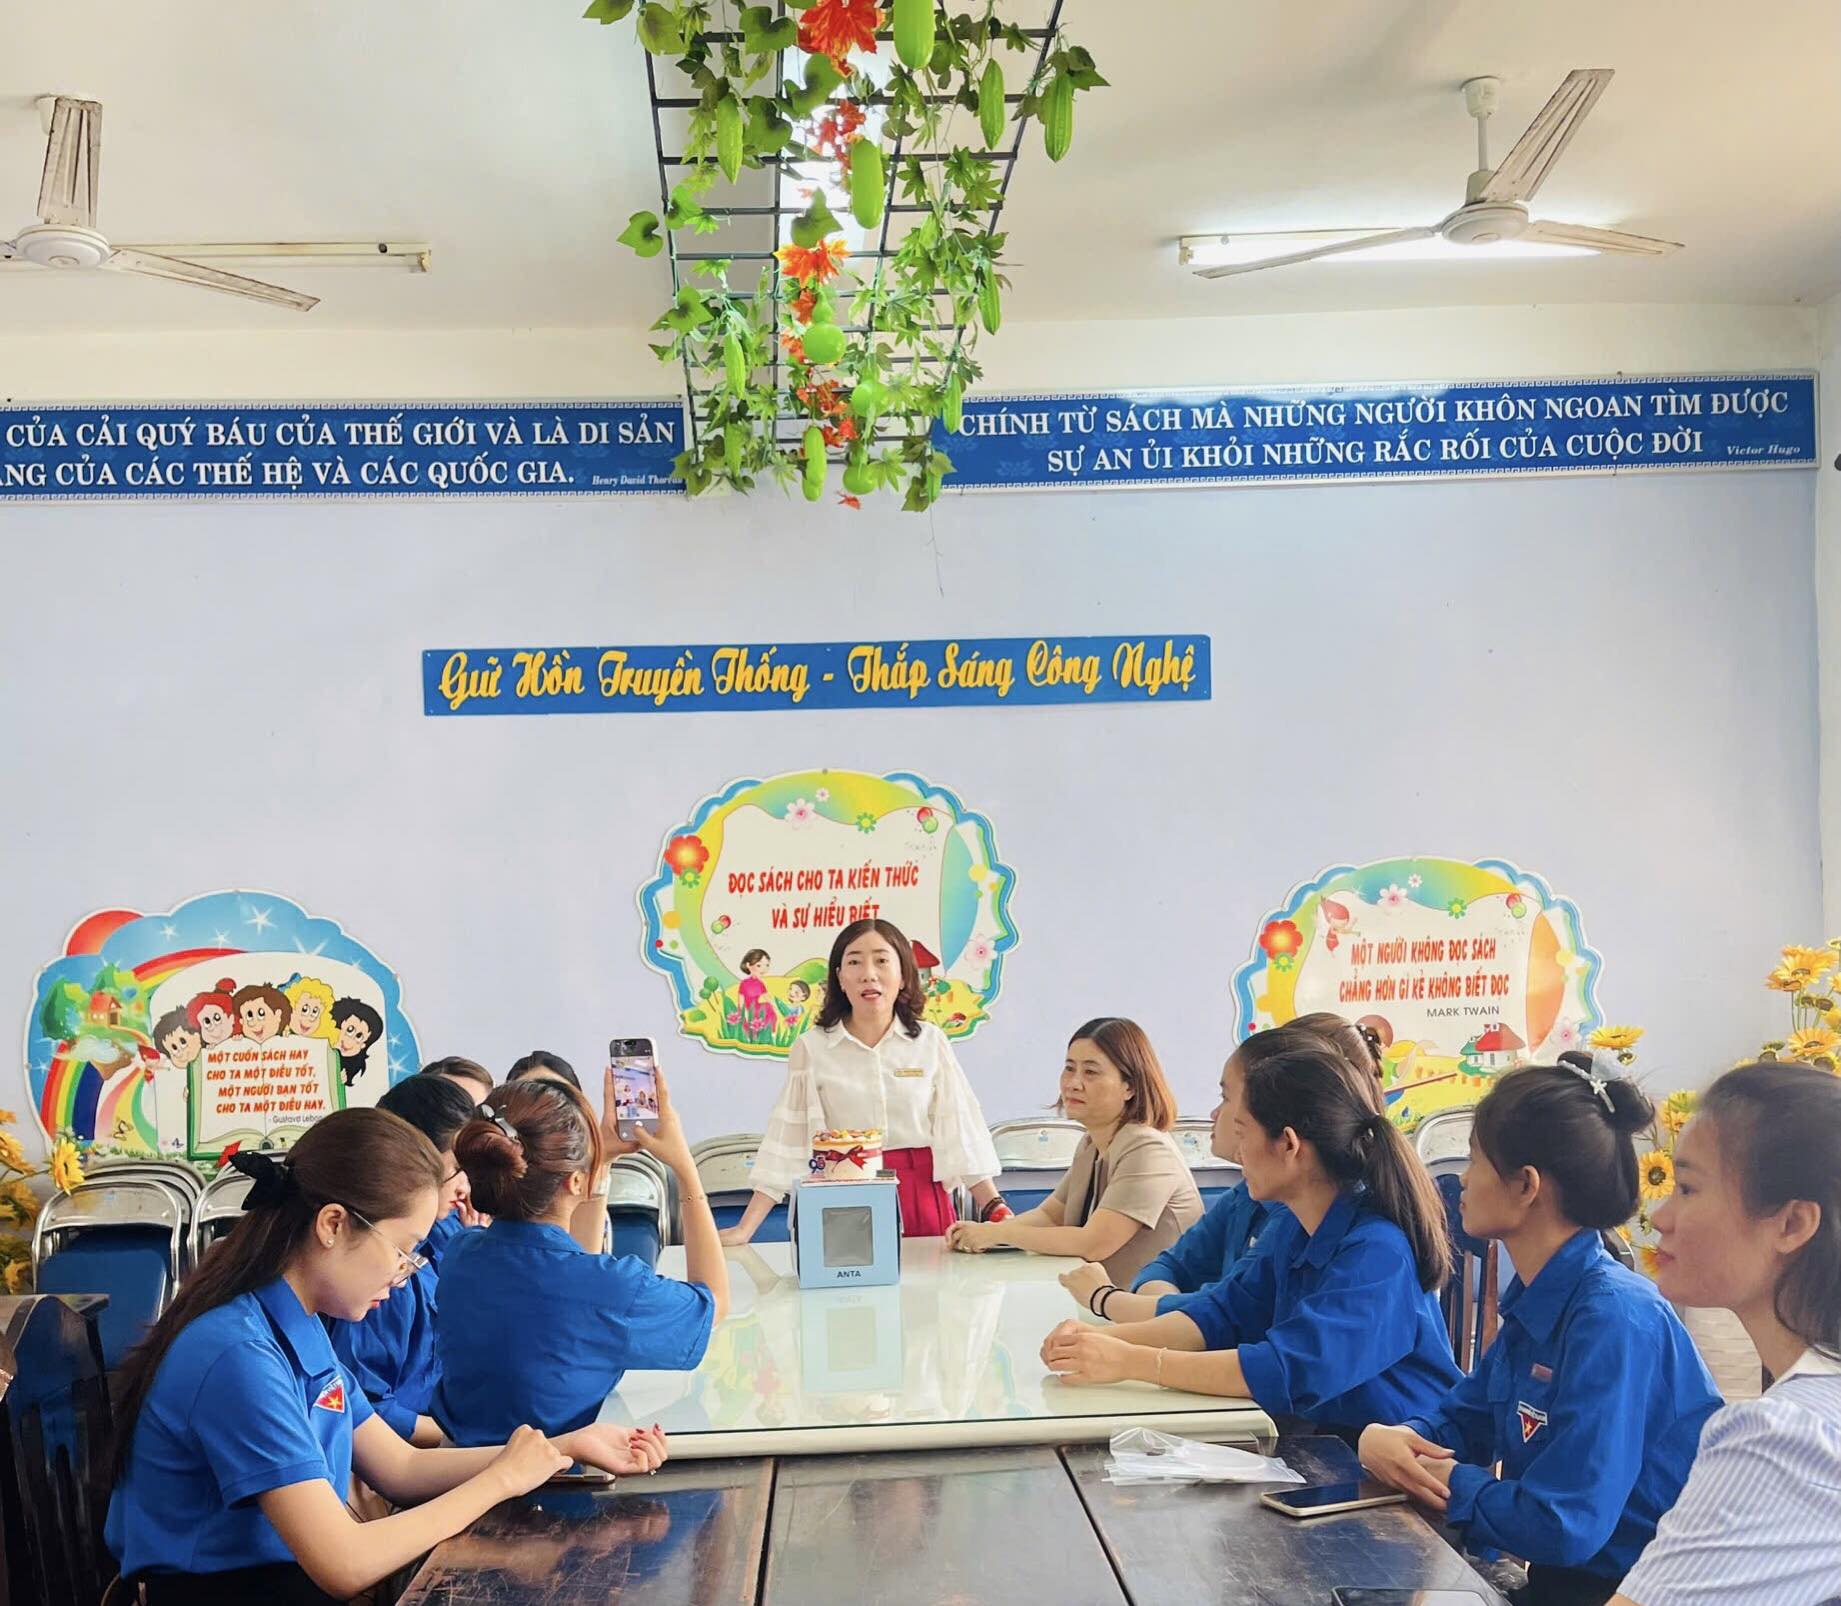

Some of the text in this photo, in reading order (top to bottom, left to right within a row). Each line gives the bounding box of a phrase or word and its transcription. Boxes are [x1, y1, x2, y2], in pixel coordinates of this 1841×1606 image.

[958, 387, 1789, 437] CHÍNH TỪ SÁCH MÀ NHỮNG NGƯỜI KHÔN NGOAN TÌM ĐƯỢC
[6, 412, 675, 450] CỦA CẢI QUÝ BÁU CỦA THẾ GIỚI VÀ LÀ DI SẢN
[1047, 425, 1703, 477] SỰ AN ỦI KHỎI NHỮNG RẮC RỐI CỦA CUỘC ĐỜI
[1726, 443, 1801, 456] Victor Hugo
[0, 451, 575, 491] NG CỦA CÁC THẾ HỆ VÀ CÁC QUỐC GIA.
[591, 474, 618, 487] Henry
[620, 474, 646, 484] David
[512, 649, 585, 698] Hồn
[598, 649, 704, 706] Truyền
[711, 645, 810, 703] Thống
[847, 642, 931, 699] Thắp
[938, 642, 1015, 697] Sáng
[1026, 639, 1102, 694] Công
[1112, 640, 1196, 696] Nghệ
[728, 859, 919, 899] ĐỌC SÁCH CHO TA KIẾN THỨC
[771, 903, 788, 929] VÀ
[792, 904, 810, 933] SỰ
[813, 896, 845, 927] HIỂU
[1351, 933, 1496, 968] MỘT NGƯỜI KHÔNG ĐỌC SÁCH
[1375, 976, 1396, 1001] HƠN
[1412, 970, 1426, 1000] KẺ
[1428, 971, 1462, 1000] KHÔNG
[1465, 966, 1487, 998] BIẾT
[1490, 974, 1510, 1001] ĐỌC
[1426, 1005, 1500, 1018] MARK TWAIN
[206, 1070, 226, 1080] CHO
[229, 1069, 241, 1080] TA
[269, 1064, 292, 1079] ĐIỀU
[207, 1050, 230, 1064] MỘT
[232, 1048, 259, 1063] CUỐN
[289, 1049, 309, 1060] HAY
[216, 1103, 236, 1114] CHO
[239, 1102, 251, 1113] TA
[253, 1099, 277, 1113] MỘT
[279, 1098, 302, 1111] ĐIỀU
[218, 1085, 240, 1098] MỘT
[243, 1083, 274, 1096] NGƯỜI
[300, 1081, 319, 1094] TỐT
[836, 1270, 861, 1279] ANTA
